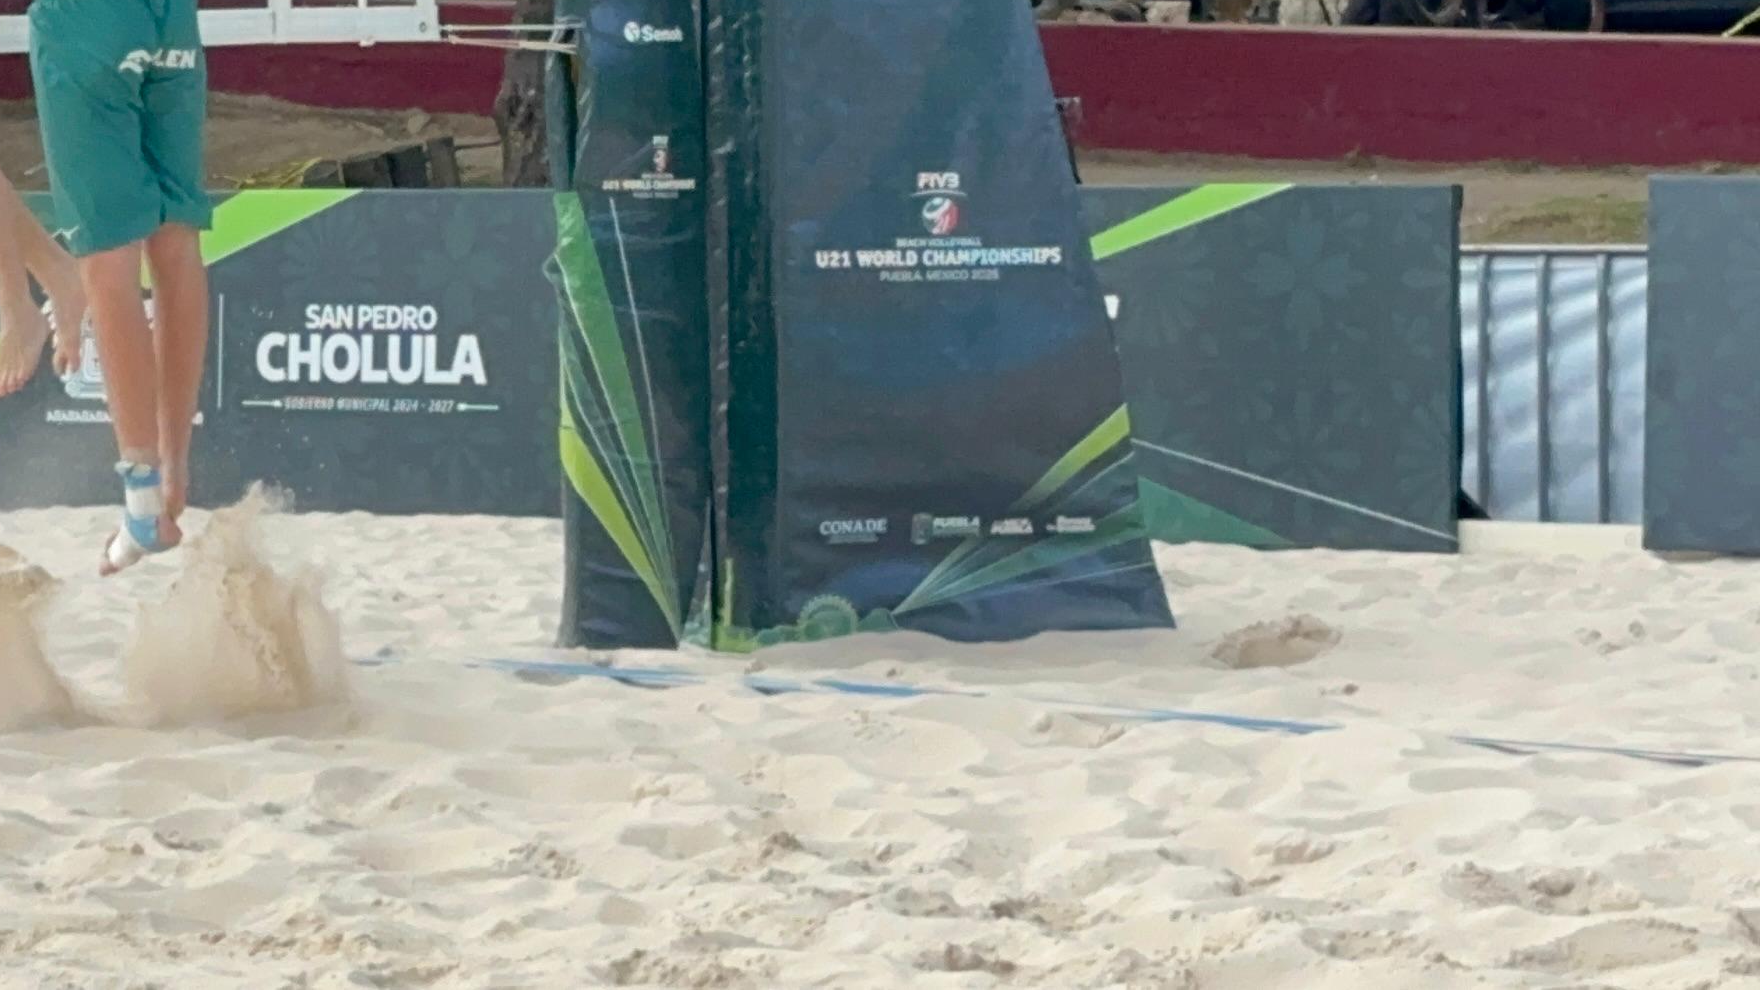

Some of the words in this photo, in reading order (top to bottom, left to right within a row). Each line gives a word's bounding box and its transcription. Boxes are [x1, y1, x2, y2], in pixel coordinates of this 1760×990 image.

[815, 250, 852, 269] U21
[856, 249, 918, 268] WORLD
[922, 246, 1063, 266] CHAMPIONSHIPS
[305, 304, 354, 330] SAN
[357, 305, 438, 331] PEDRO
[256, 332, 488, 385] CHOLULA
[819, 518, 888, 535] CONADE
